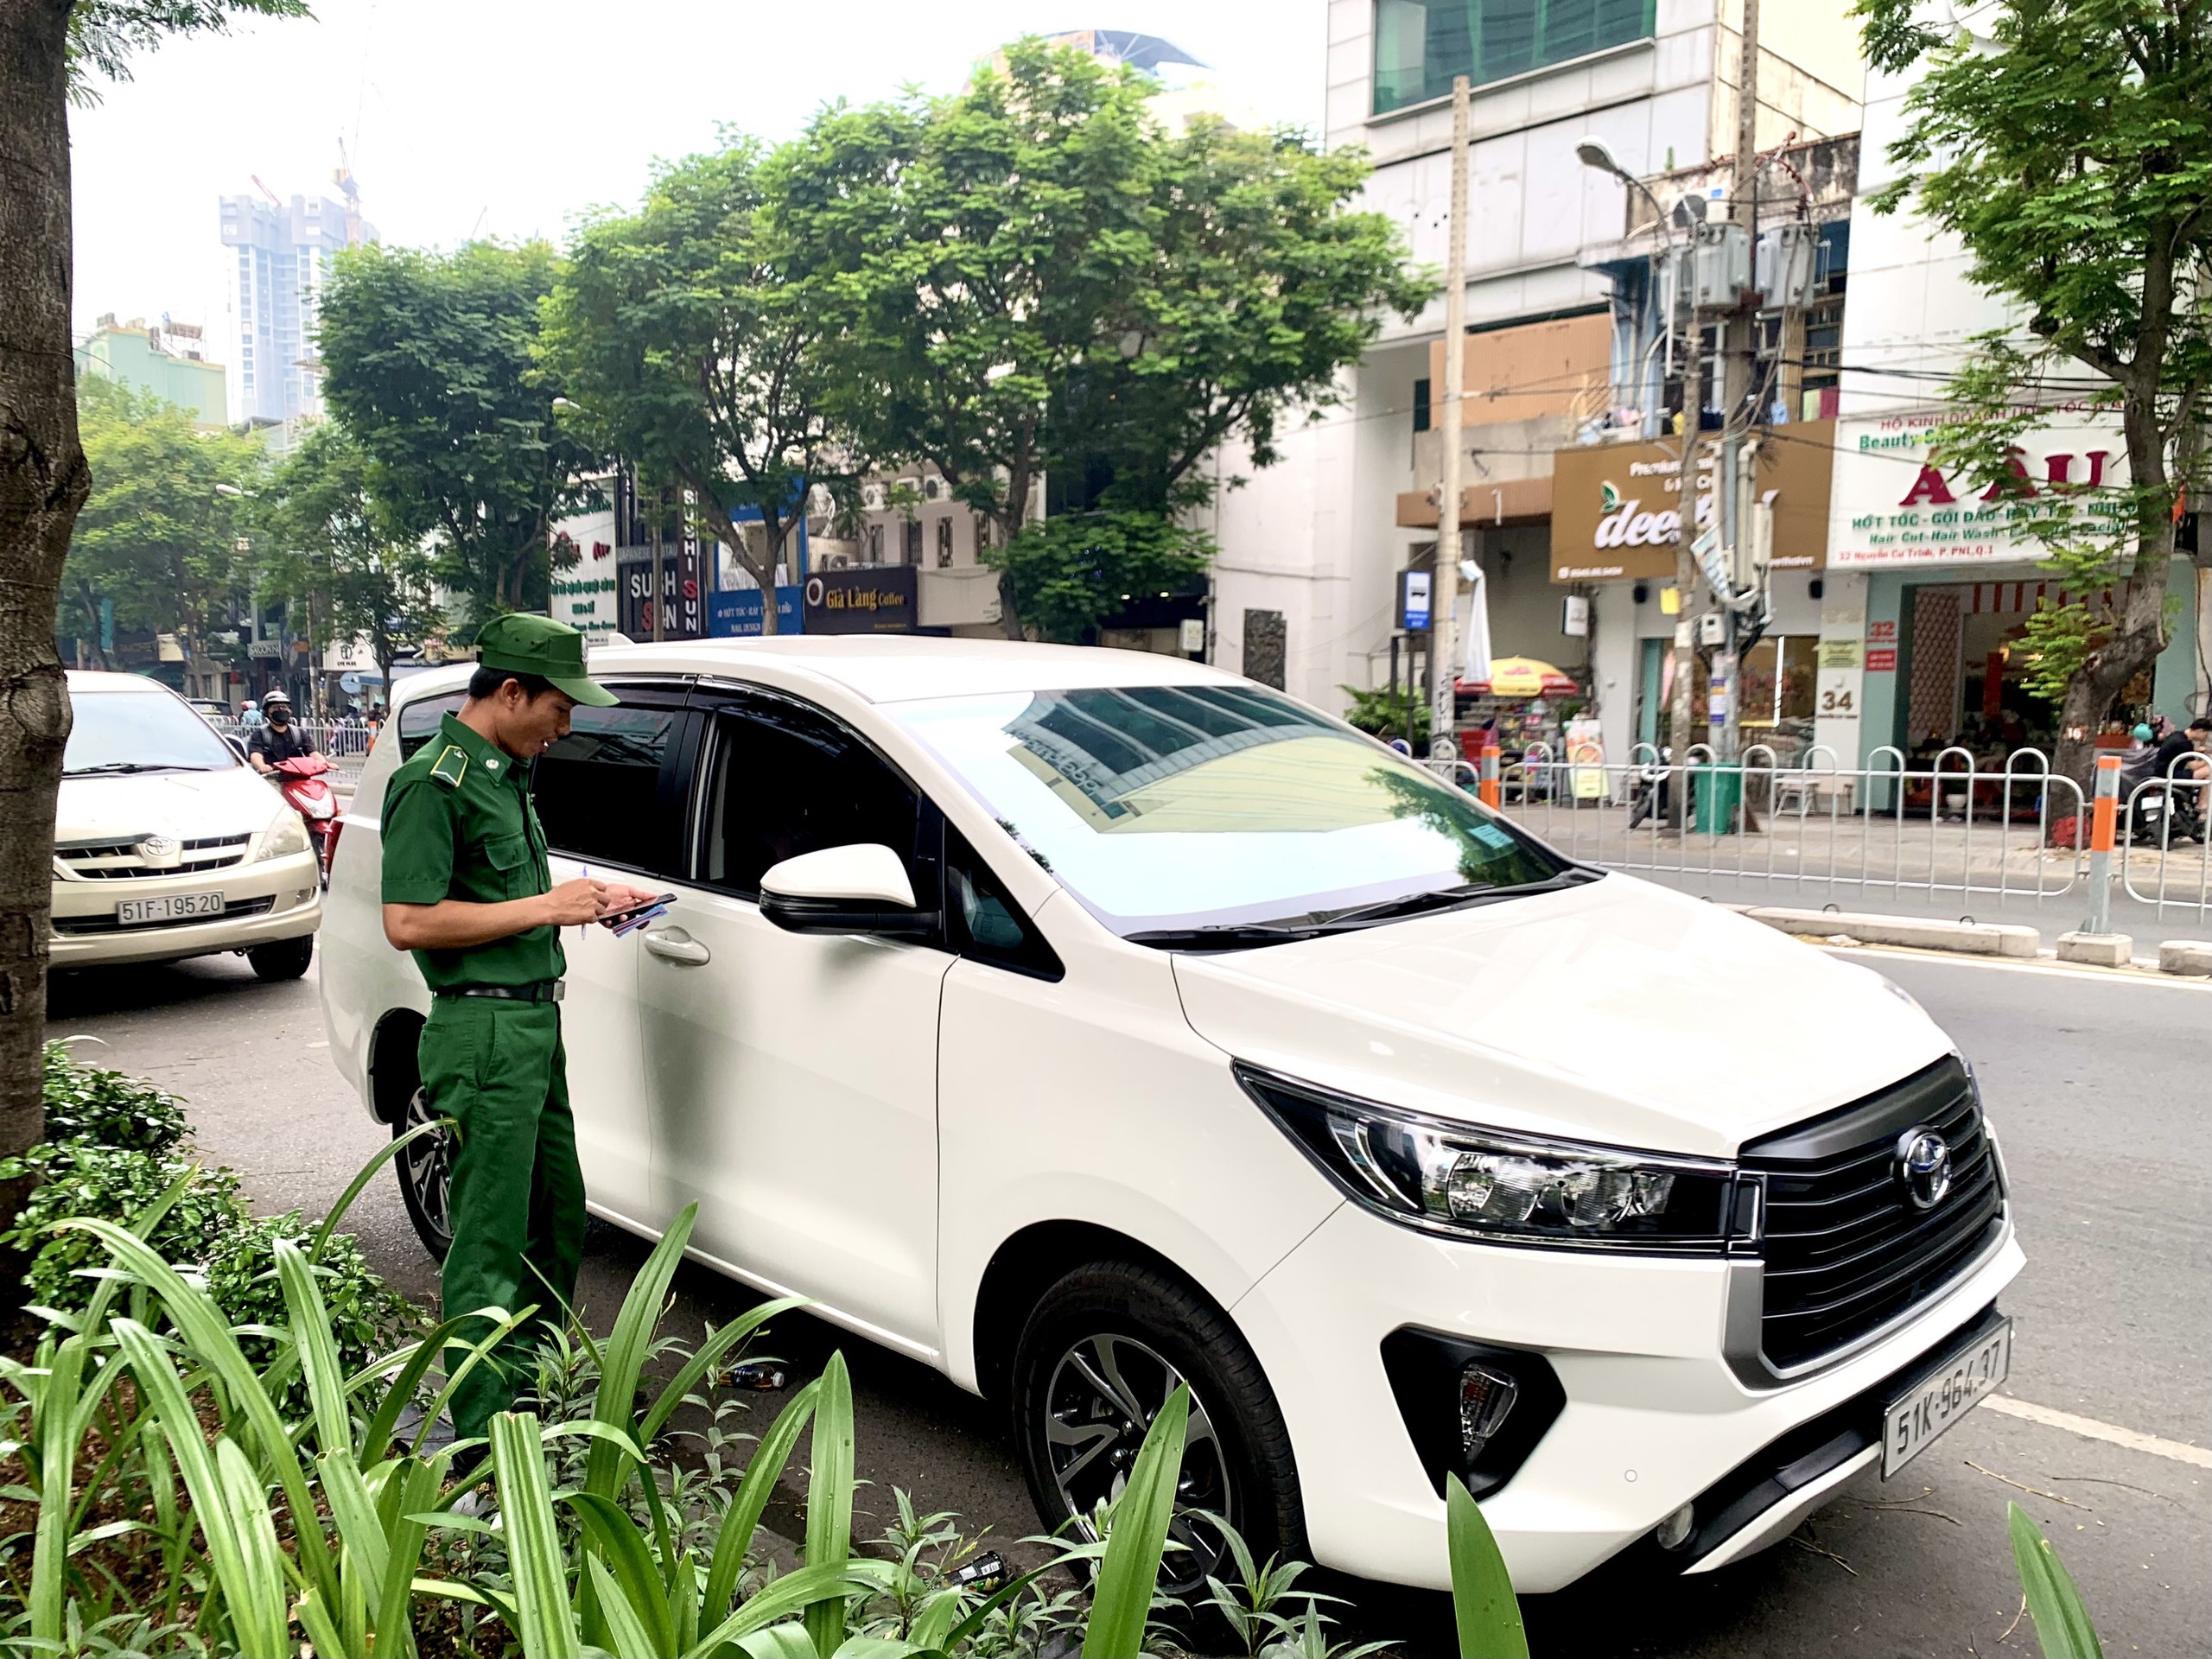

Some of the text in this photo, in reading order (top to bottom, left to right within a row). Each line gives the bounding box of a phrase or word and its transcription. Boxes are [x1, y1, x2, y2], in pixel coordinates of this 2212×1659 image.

[1859, 431, 1916, 451] Beauty
[683, 579, 698, 632] SUN
[879, 592, 905, 606] Coffee
[641, 601, 677, 632] SN
[1870, 620, 1896, 637] 32
[1821, 690, 1853, 711] 34
[122, 894, 221, 921] 51F-195.20
[1897, 1339, 2001, 1455] 51K-964.37
